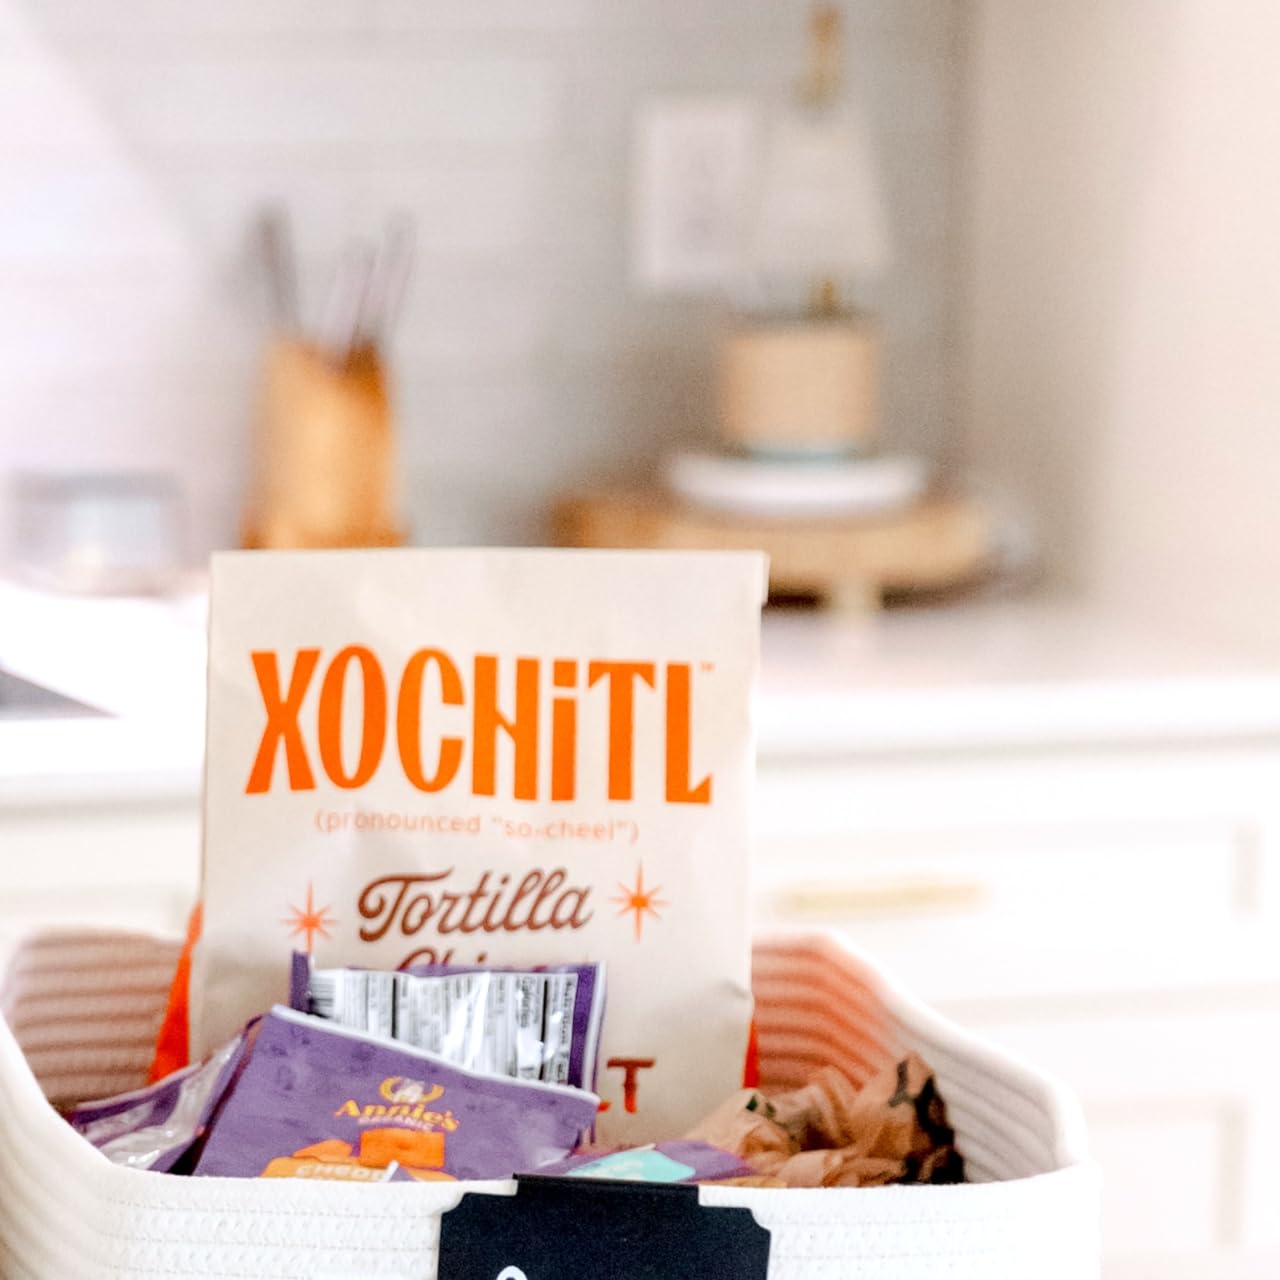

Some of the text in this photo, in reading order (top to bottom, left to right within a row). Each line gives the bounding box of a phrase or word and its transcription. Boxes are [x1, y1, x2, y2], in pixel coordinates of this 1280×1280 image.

[314, 808, 482, 836] (pronounced
[357, 865, 595, 943] Tortilla
[334, 1099, 460, 1132] Annie's
